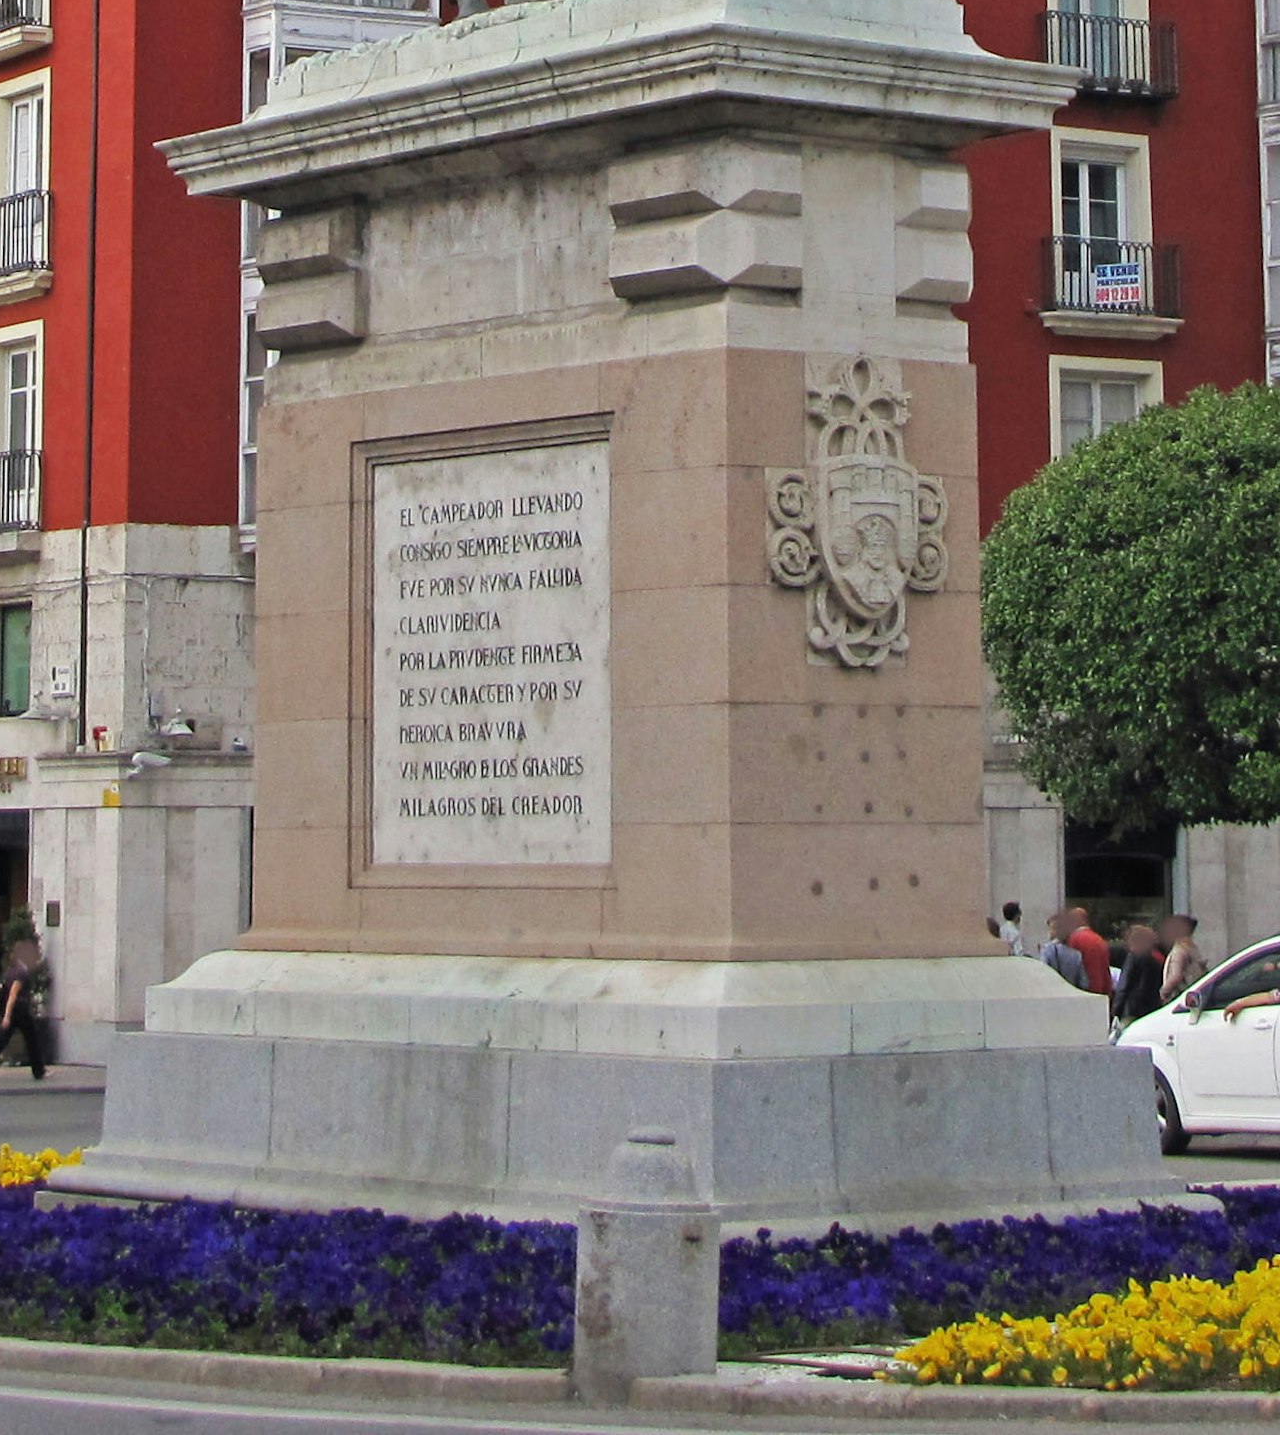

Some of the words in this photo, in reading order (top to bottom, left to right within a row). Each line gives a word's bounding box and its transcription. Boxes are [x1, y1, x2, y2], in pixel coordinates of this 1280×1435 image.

[1096, 266, 1108, 277] SE
[1110, 265, 1139, 276] VENDE
[400, 508, 414, 527] EL
[421, 500, 503, 524] CAMPEADOR
[512, 491, 583, 517] LLEVANDO
[400, 541, 451, 562] CONSIGO
[457, 535, 509, 558] SIEMPRE
[523, 530, 582, 552] VICTORIA
[430, 577, 454, 597] POR
[529, 567, 582, 589] FALLIDA
[400, 611, 501, 634] CLARIVIDENCIA
[400, 652, 424, 671] POR
[429, 651, 446, 670] LA
[400, 688, 414, 707] DE
[441, 683, 514, 705] CARACTER
[517, 683, 526, 702] Y
[530, 681, 557, 701] POR
[422, 759, 476, 780] MILAGRO
[494, 758, 518, 778] LOS
[523, 756, 584, 778] GRANDES
[399, 796, 476, 817] MILAGROS
[481, 797, 504, 816] DEL
[512, 795, 583, 815] CREADOR
